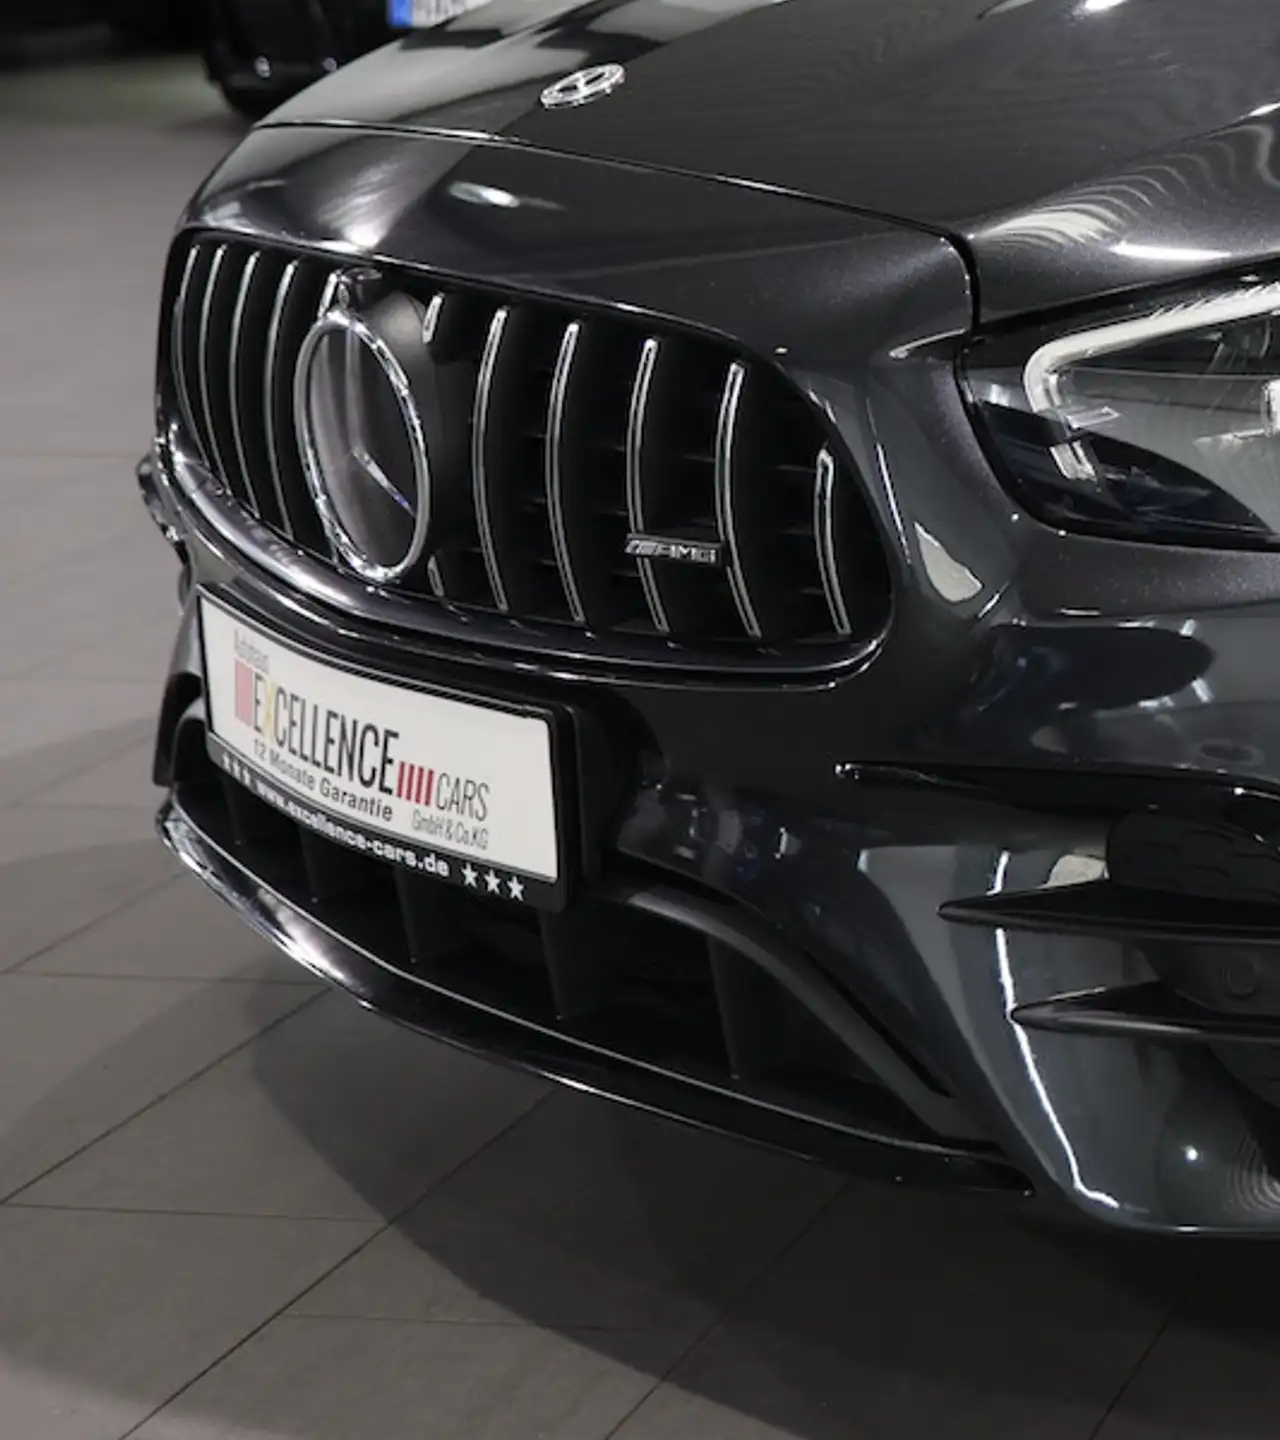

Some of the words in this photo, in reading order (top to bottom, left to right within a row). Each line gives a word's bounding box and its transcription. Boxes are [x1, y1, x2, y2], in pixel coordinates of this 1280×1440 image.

[252, 672, 400, 796] EXCELLENCE
[435, 772, 491, 822] CARS
[253, 738, 267, 760] 12
[269, 747, 316, 791] Monate
[319, 776, 394, 822] Garantie
